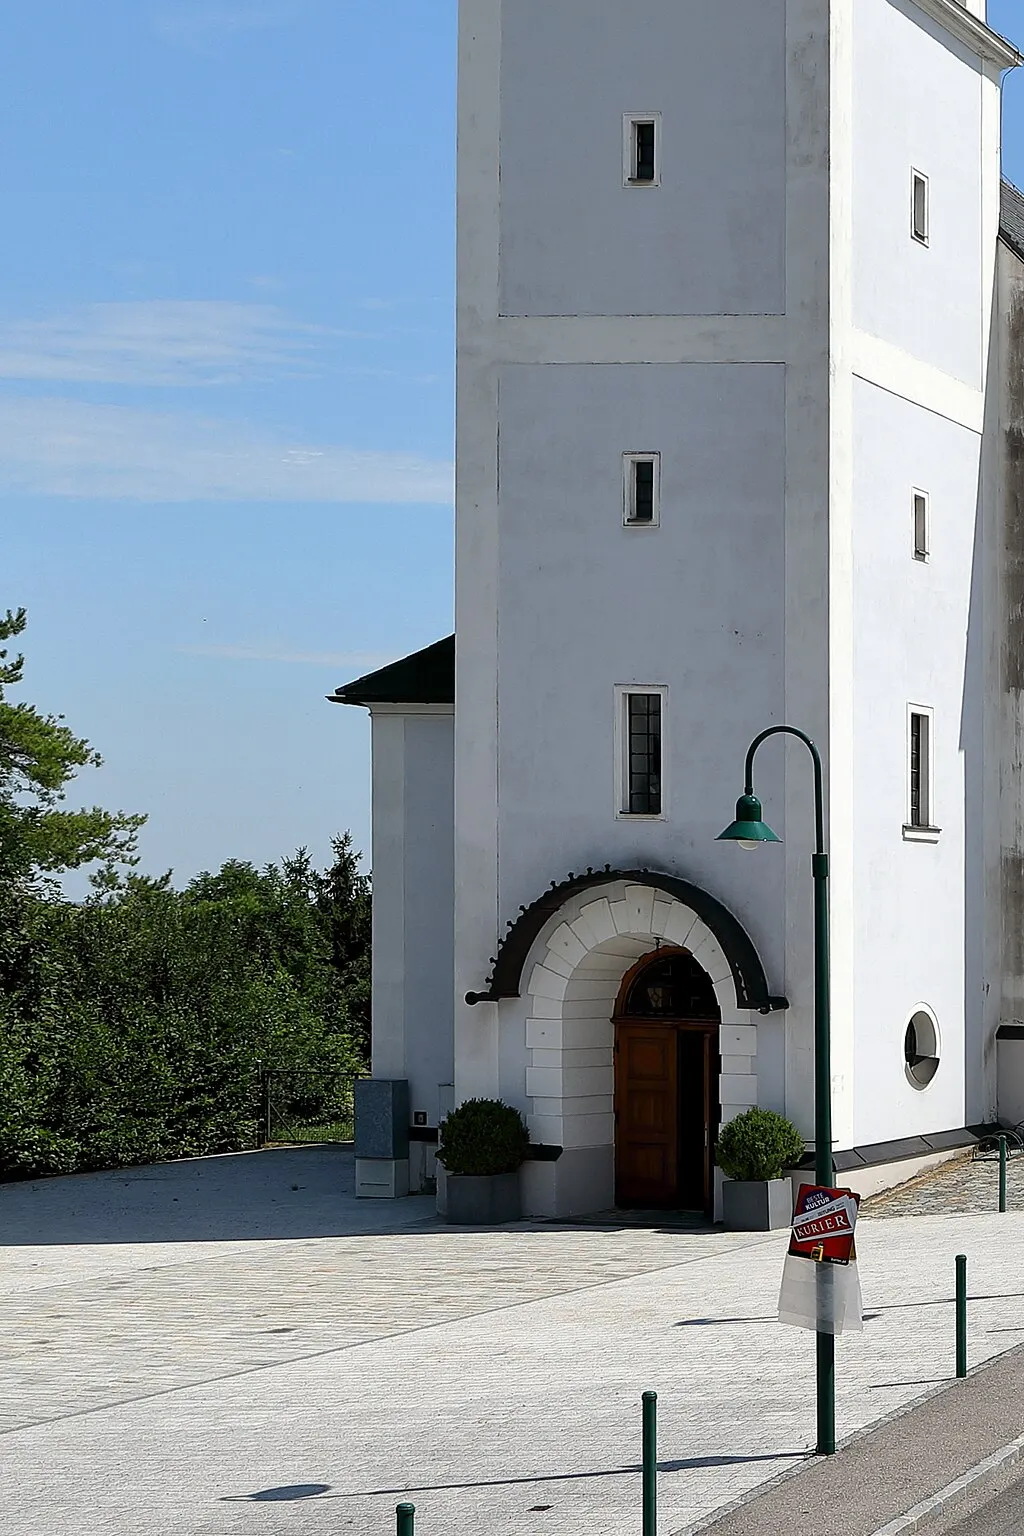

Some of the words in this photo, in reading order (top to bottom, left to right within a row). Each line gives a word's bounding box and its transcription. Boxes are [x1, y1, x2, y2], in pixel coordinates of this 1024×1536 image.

[805, 1196, 830, 1211] KULTUR
[806, 1192, 824, 1204] BESTE
[797, 1215, 848, 1237] KURIER
